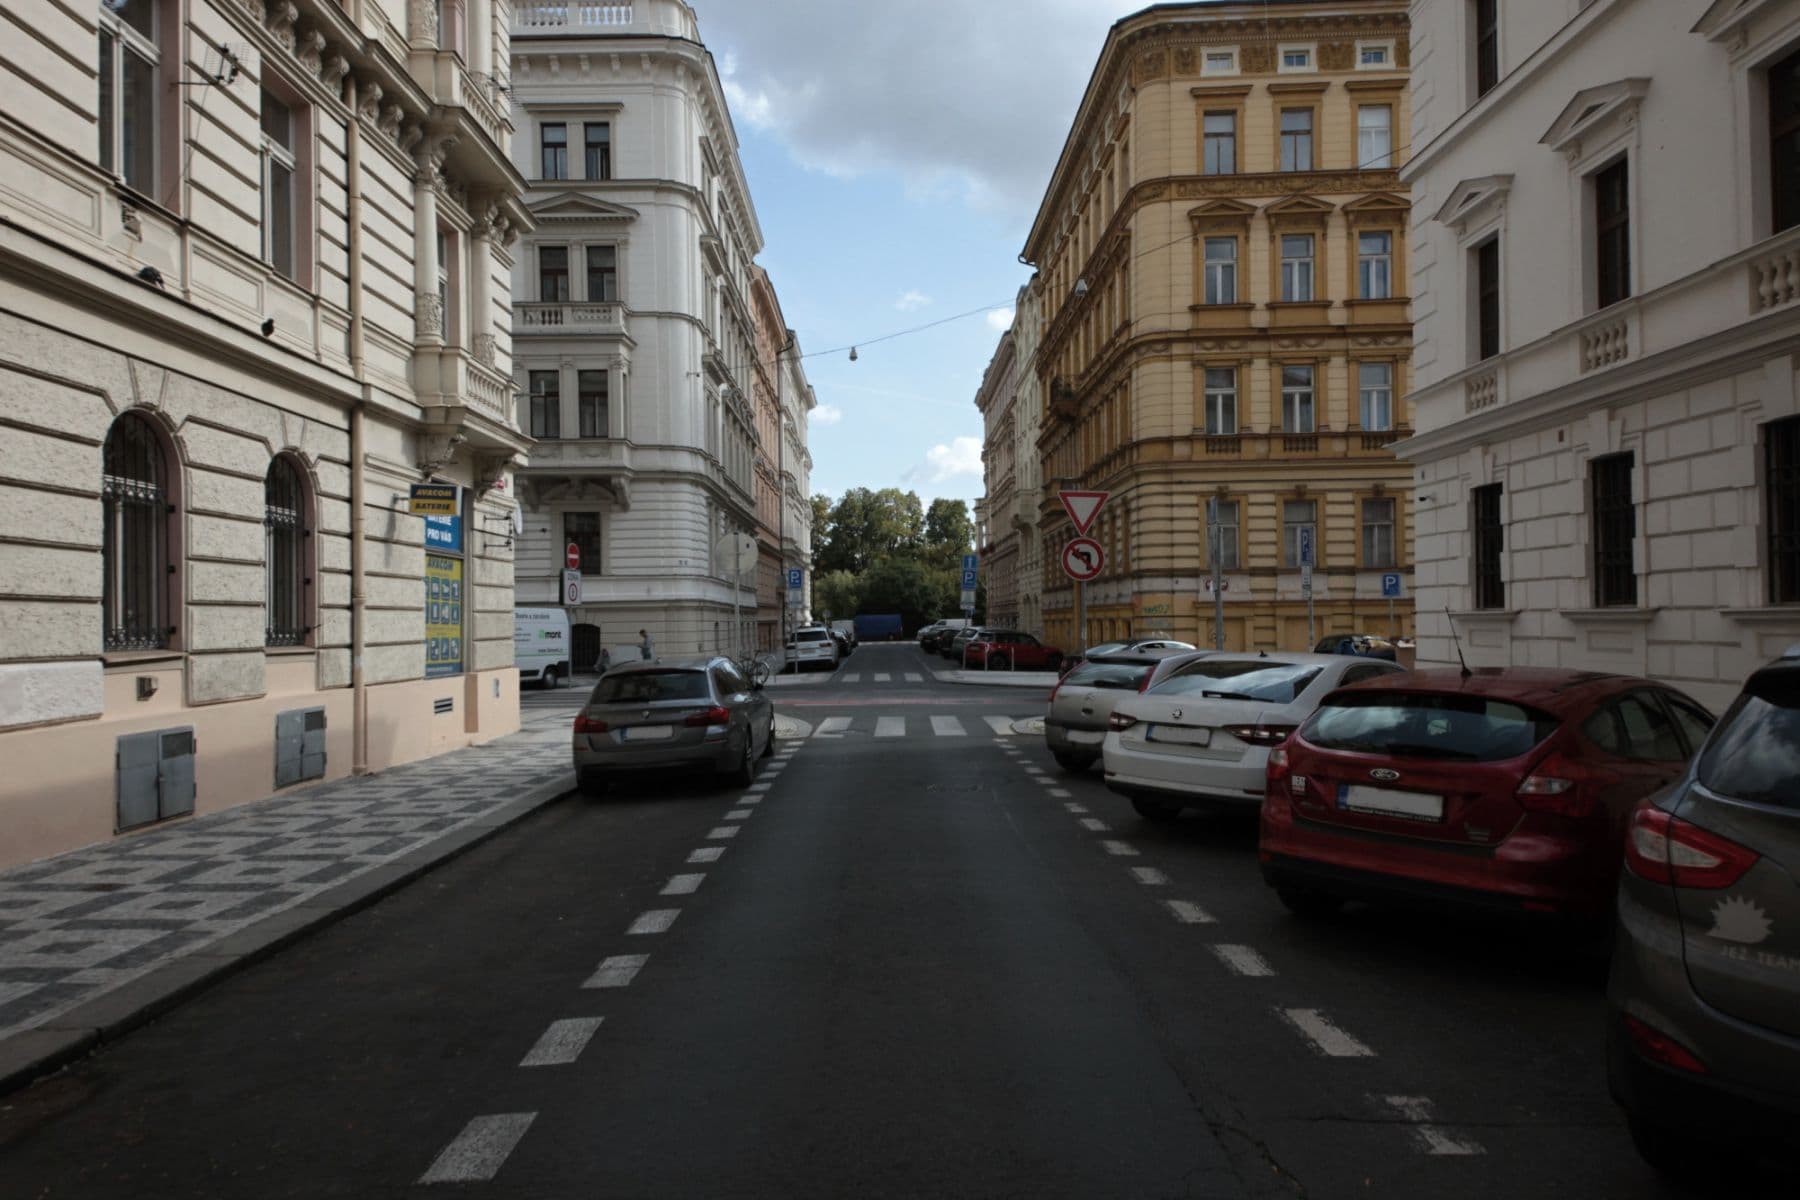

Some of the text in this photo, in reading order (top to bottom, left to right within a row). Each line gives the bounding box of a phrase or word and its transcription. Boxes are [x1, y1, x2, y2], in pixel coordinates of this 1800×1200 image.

[416, 489, 452, 497] AVACOM
[415, 502, 451, 510] BATERIE
[427, 528, 440, 540] PRO
[790, 570, 800, 583] P
[964, 571, 974, 584] P
[1385, 575, 1397, 591] P
